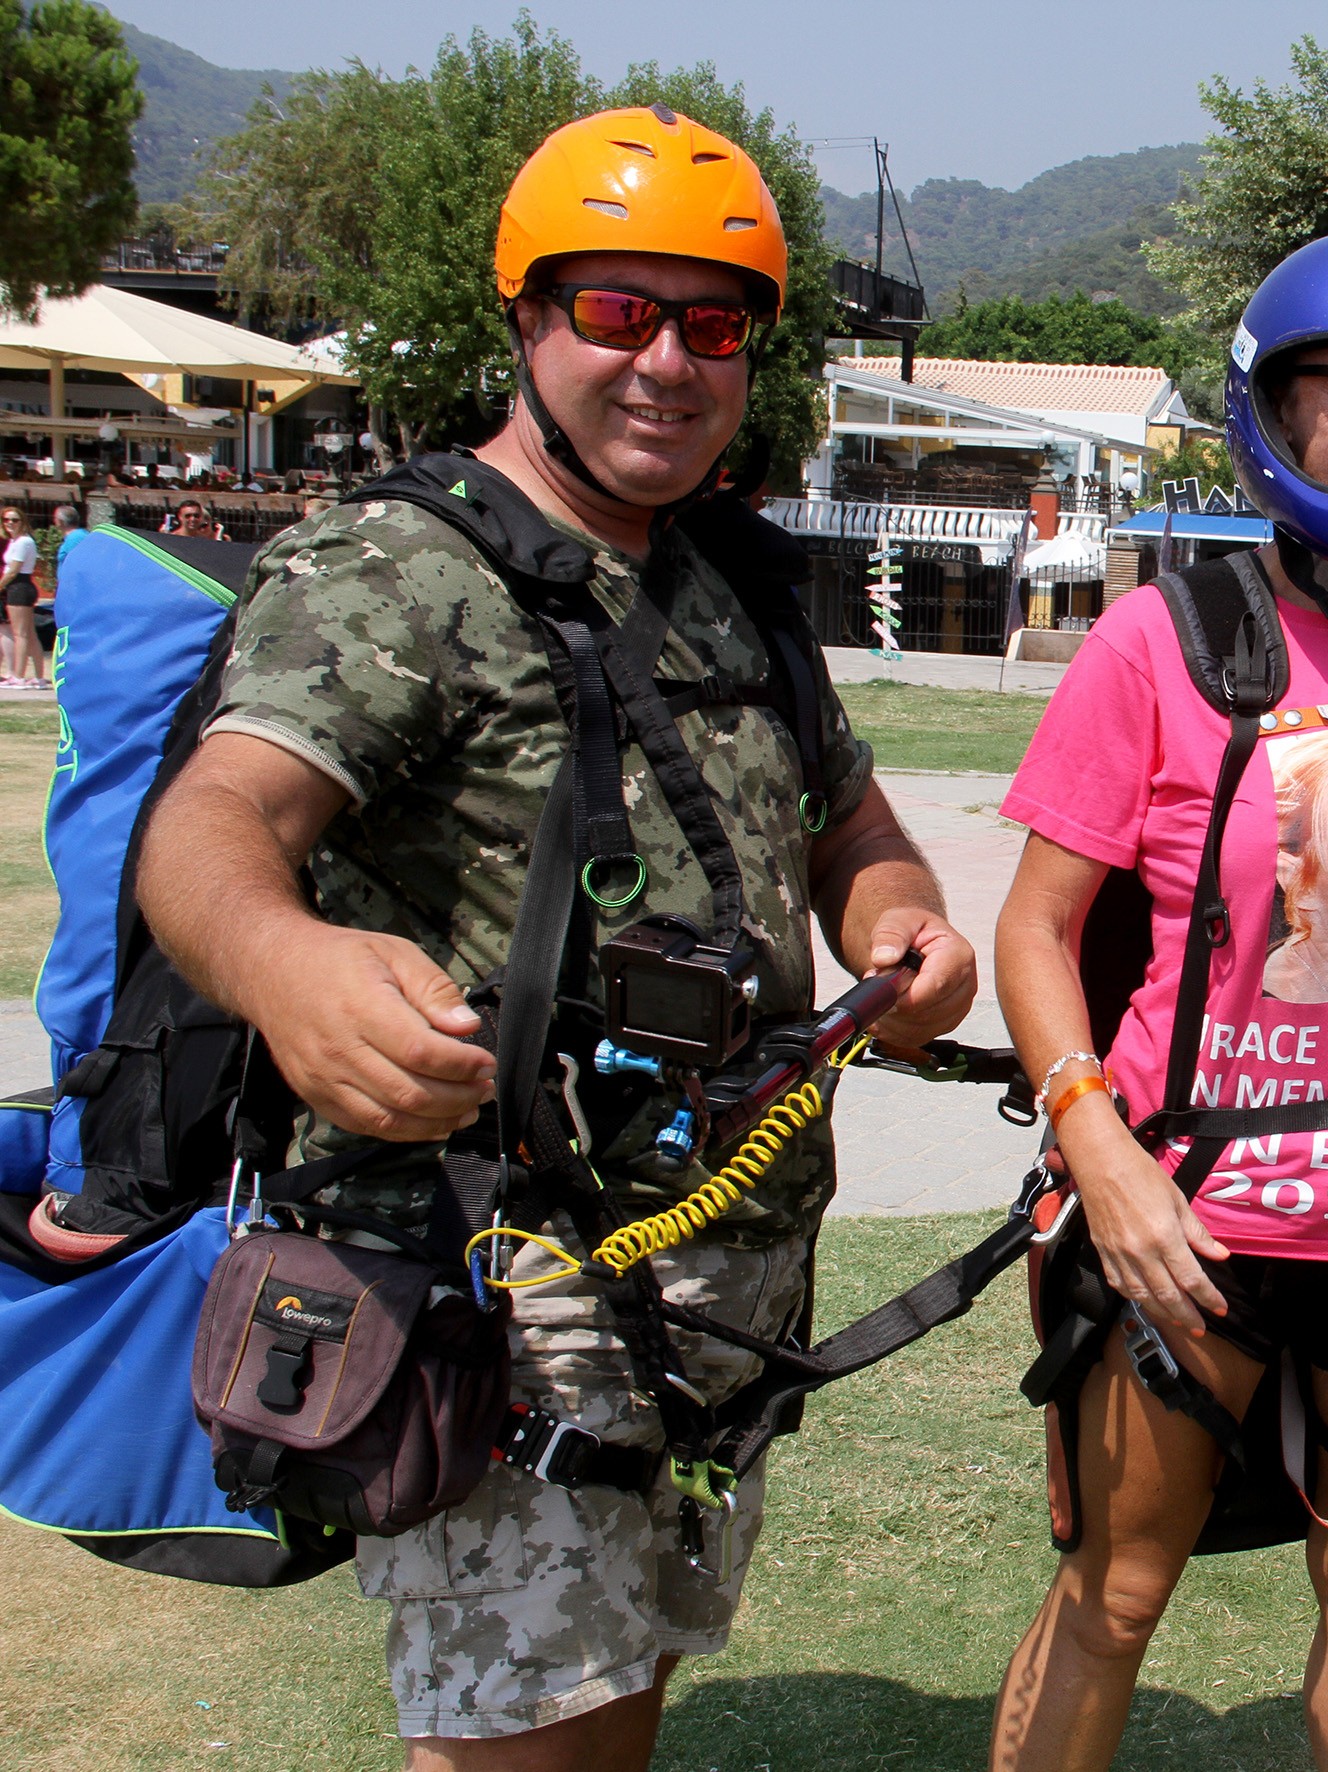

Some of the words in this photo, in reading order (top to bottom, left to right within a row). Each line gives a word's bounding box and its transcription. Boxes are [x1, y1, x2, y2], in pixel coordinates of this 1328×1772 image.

[912, 545, 962, 561] BEACH
[1210, 1022, 1320, 1065] RACE
[281, 1307, 332, 1327] Lowepro
